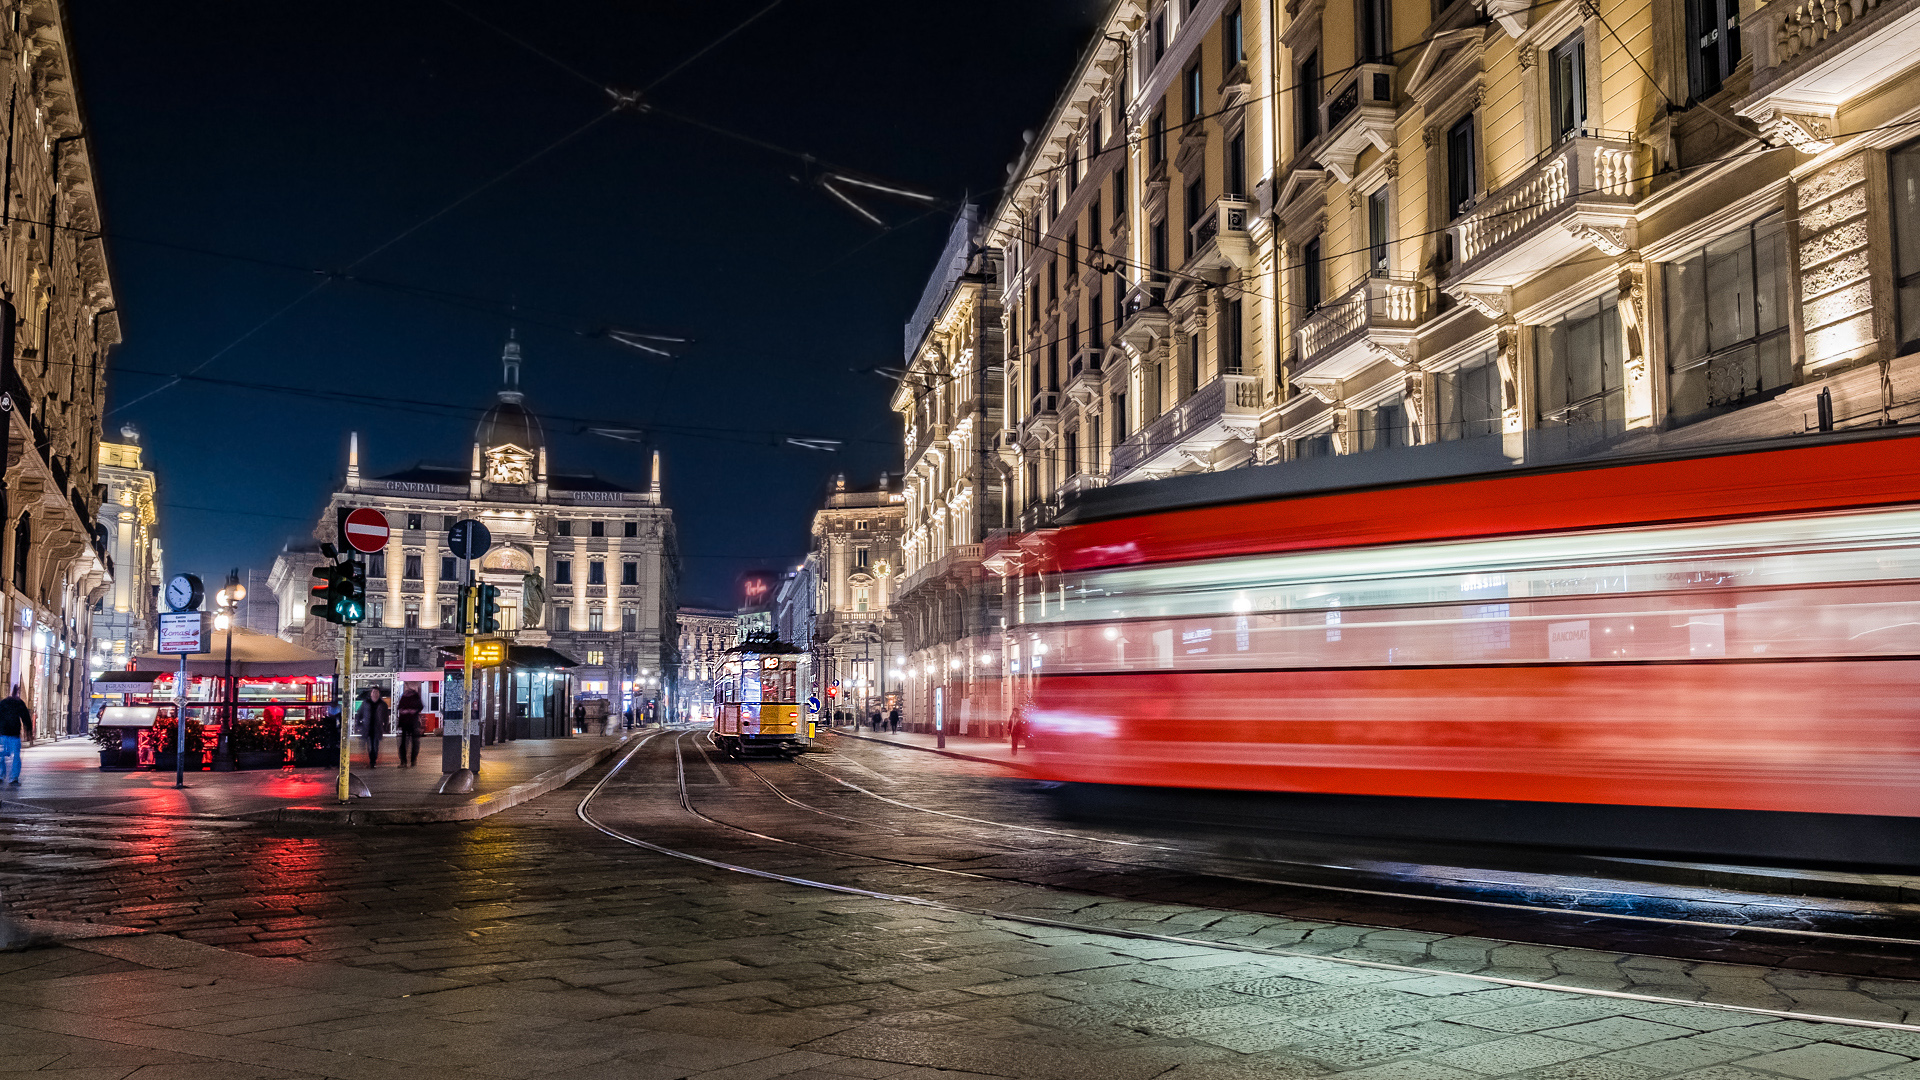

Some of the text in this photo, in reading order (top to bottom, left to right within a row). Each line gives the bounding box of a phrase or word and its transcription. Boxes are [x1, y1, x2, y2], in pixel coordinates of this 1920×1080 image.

[386, 481, 440, 493] GENERALI
[573, 491, 623, 501] GENERALI
[1552, 629, 1588, 643] BANCOMAT
